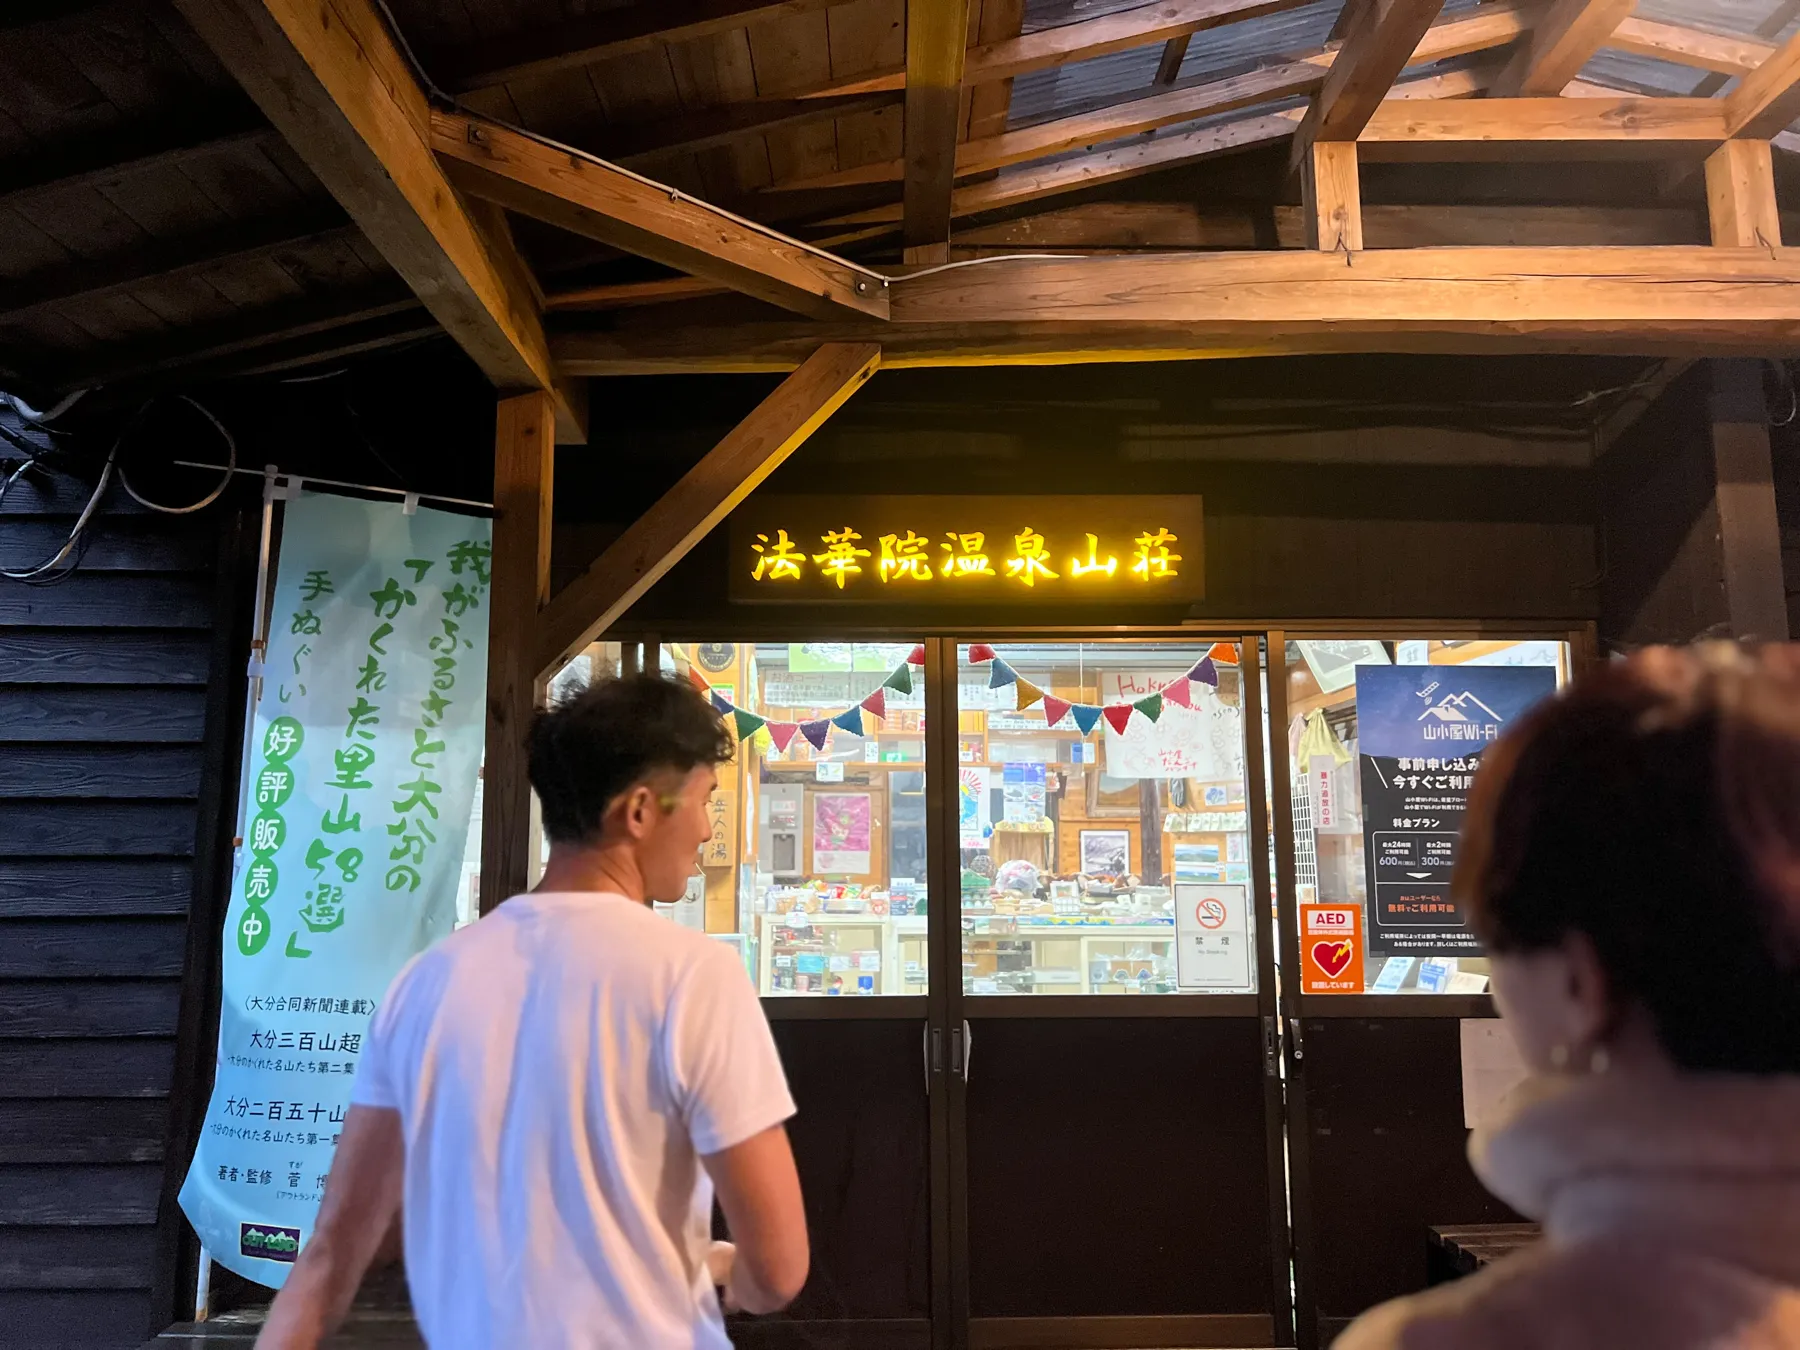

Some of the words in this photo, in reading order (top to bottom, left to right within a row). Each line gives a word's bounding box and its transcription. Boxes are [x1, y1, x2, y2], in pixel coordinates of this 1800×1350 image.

[750, 526, 1184, 589] 法華院温泉山荘
[279, 570, 335, 704] 手ぬぐい
[386, 539, 491, 893] 我がふるさと大分の
[1423, 723, 1498, 740] 山小屋Wi-Fi
[242, 723, 298, 948] 好評販売中
[1392, 818, 1440, 828] 料金プラン
[1316, 913, 1346, 924] AED
[250, 1028, 362, 1054] 大分三百山超
[223, 1095, 346, 1124] 大分二百五十山
[218, 1165, 272, 1186] 著者・監修
